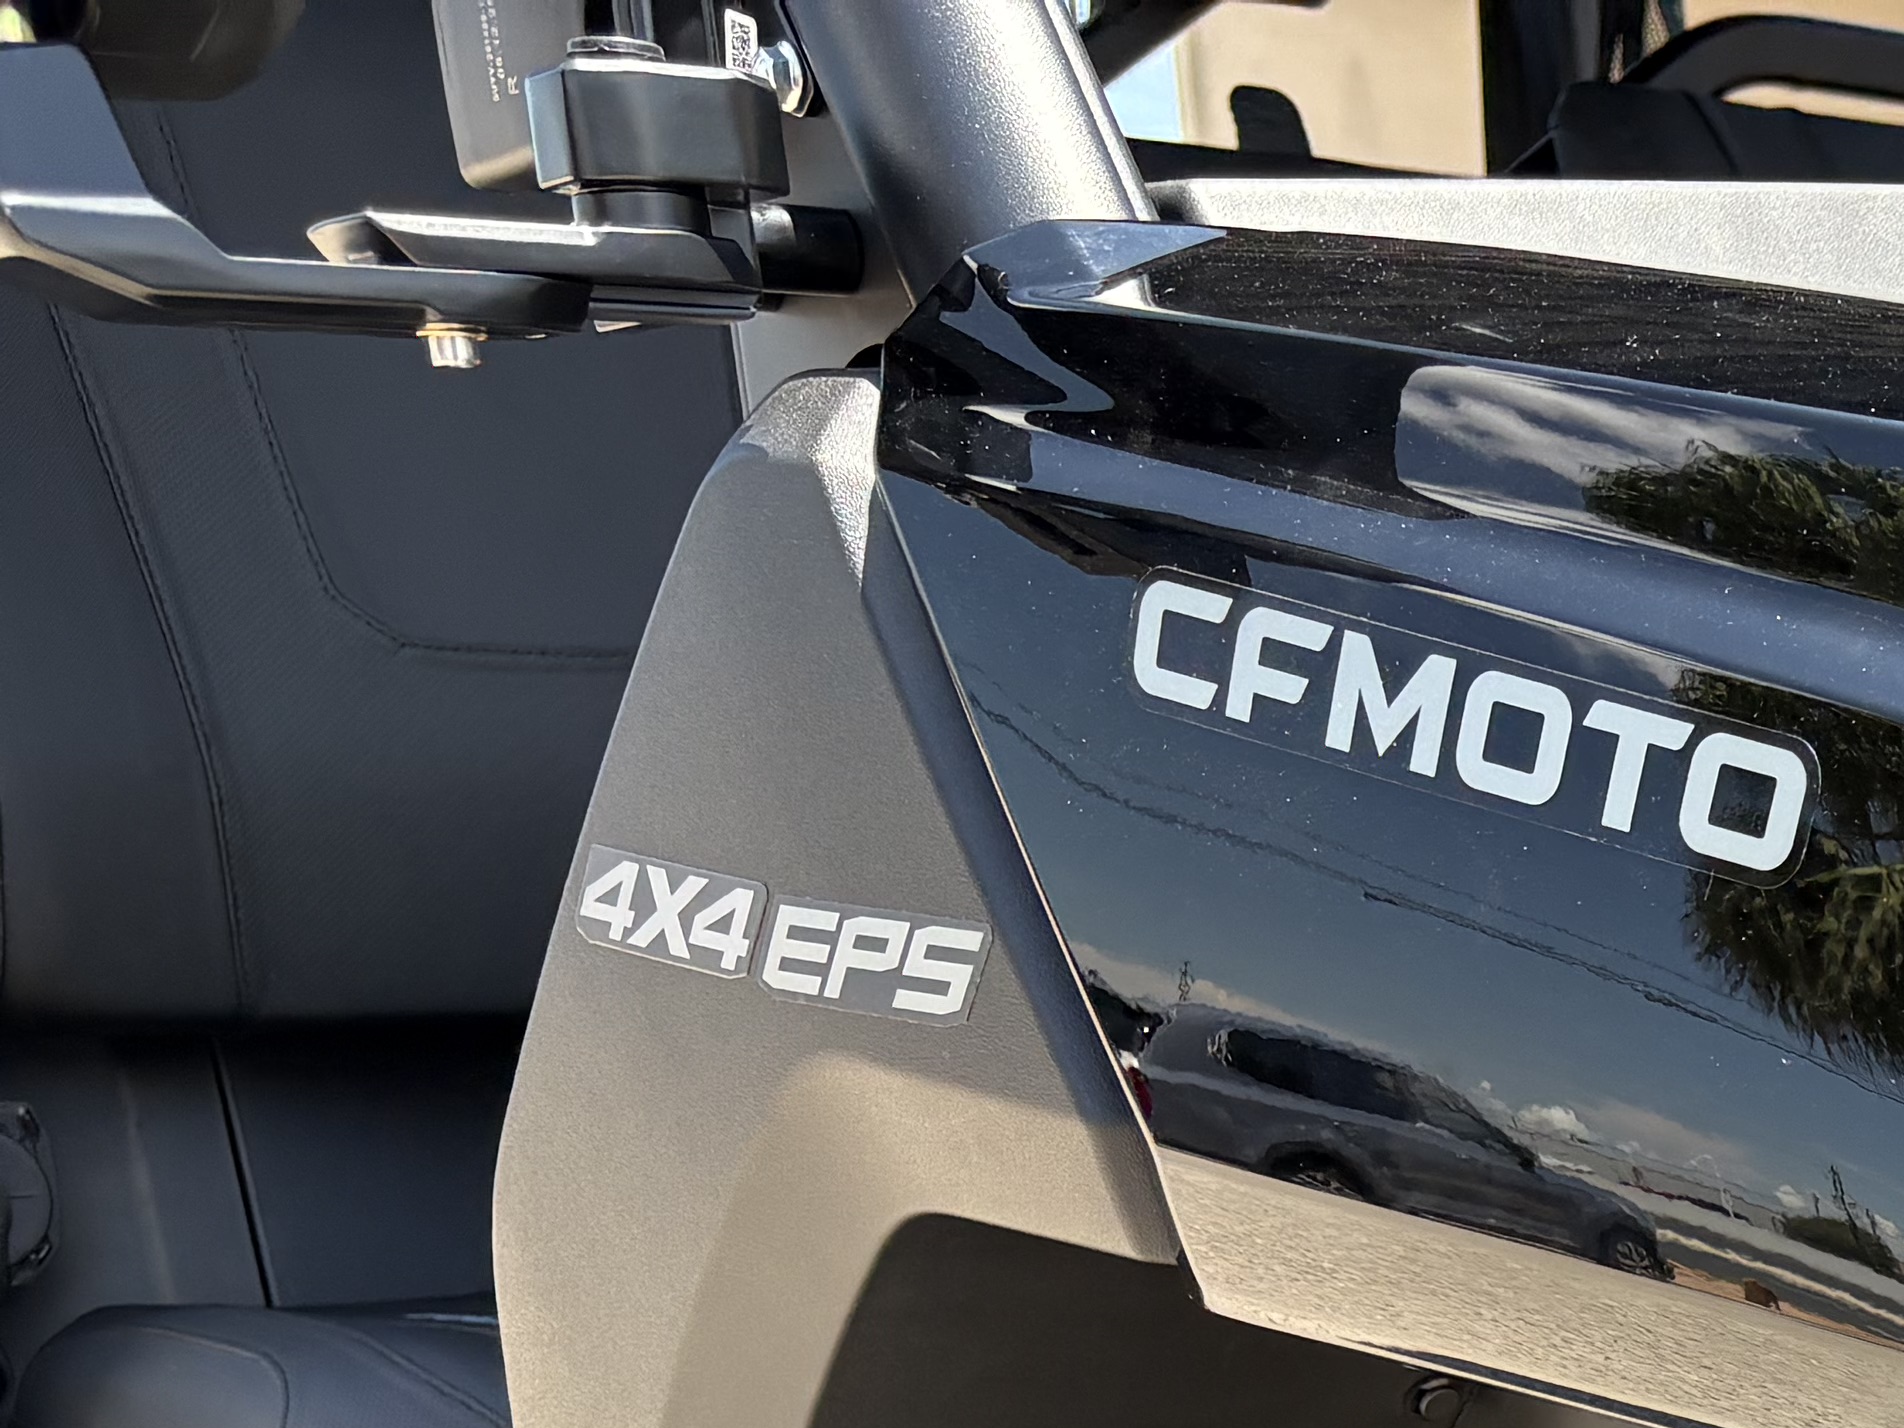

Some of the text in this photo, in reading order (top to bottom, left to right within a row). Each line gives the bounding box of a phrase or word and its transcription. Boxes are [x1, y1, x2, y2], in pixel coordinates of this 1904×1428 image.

[1133, 580, 1807, 871] CFMOTO
[580, 860, 984, 1015] 4X4 EPS
